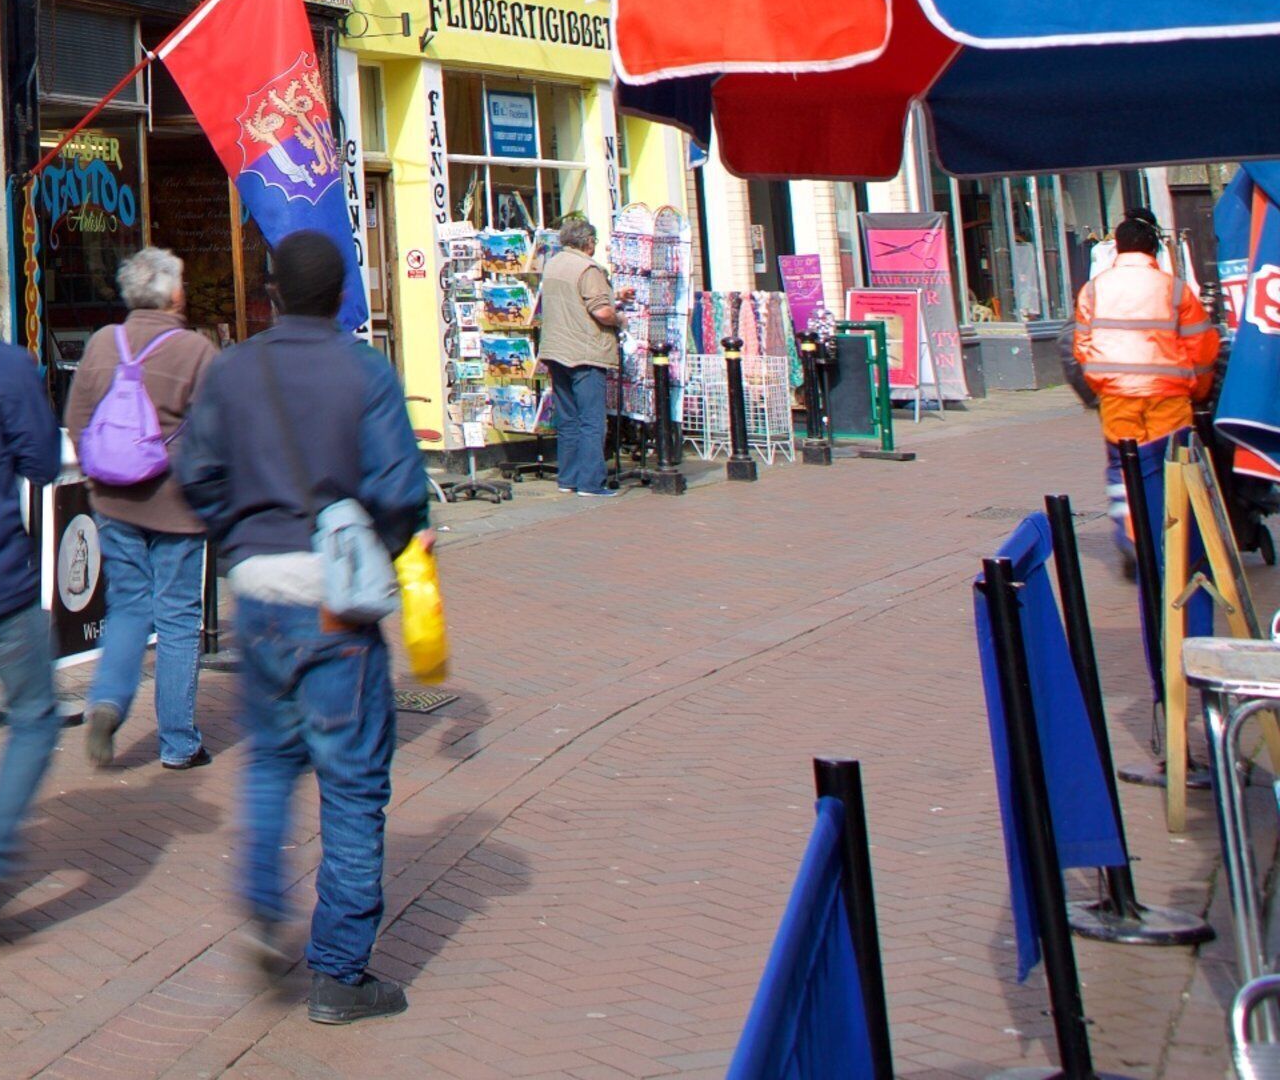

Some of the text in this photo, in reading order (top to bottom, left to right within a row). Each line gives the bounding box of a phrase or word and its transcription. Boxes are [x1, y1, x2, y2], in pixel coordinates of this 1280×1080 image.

[42, 153, 136, 231] TATTOO
[67, 191, 118, 232] Artists
[872, 275, 951, 286] HAIR TO STAY
